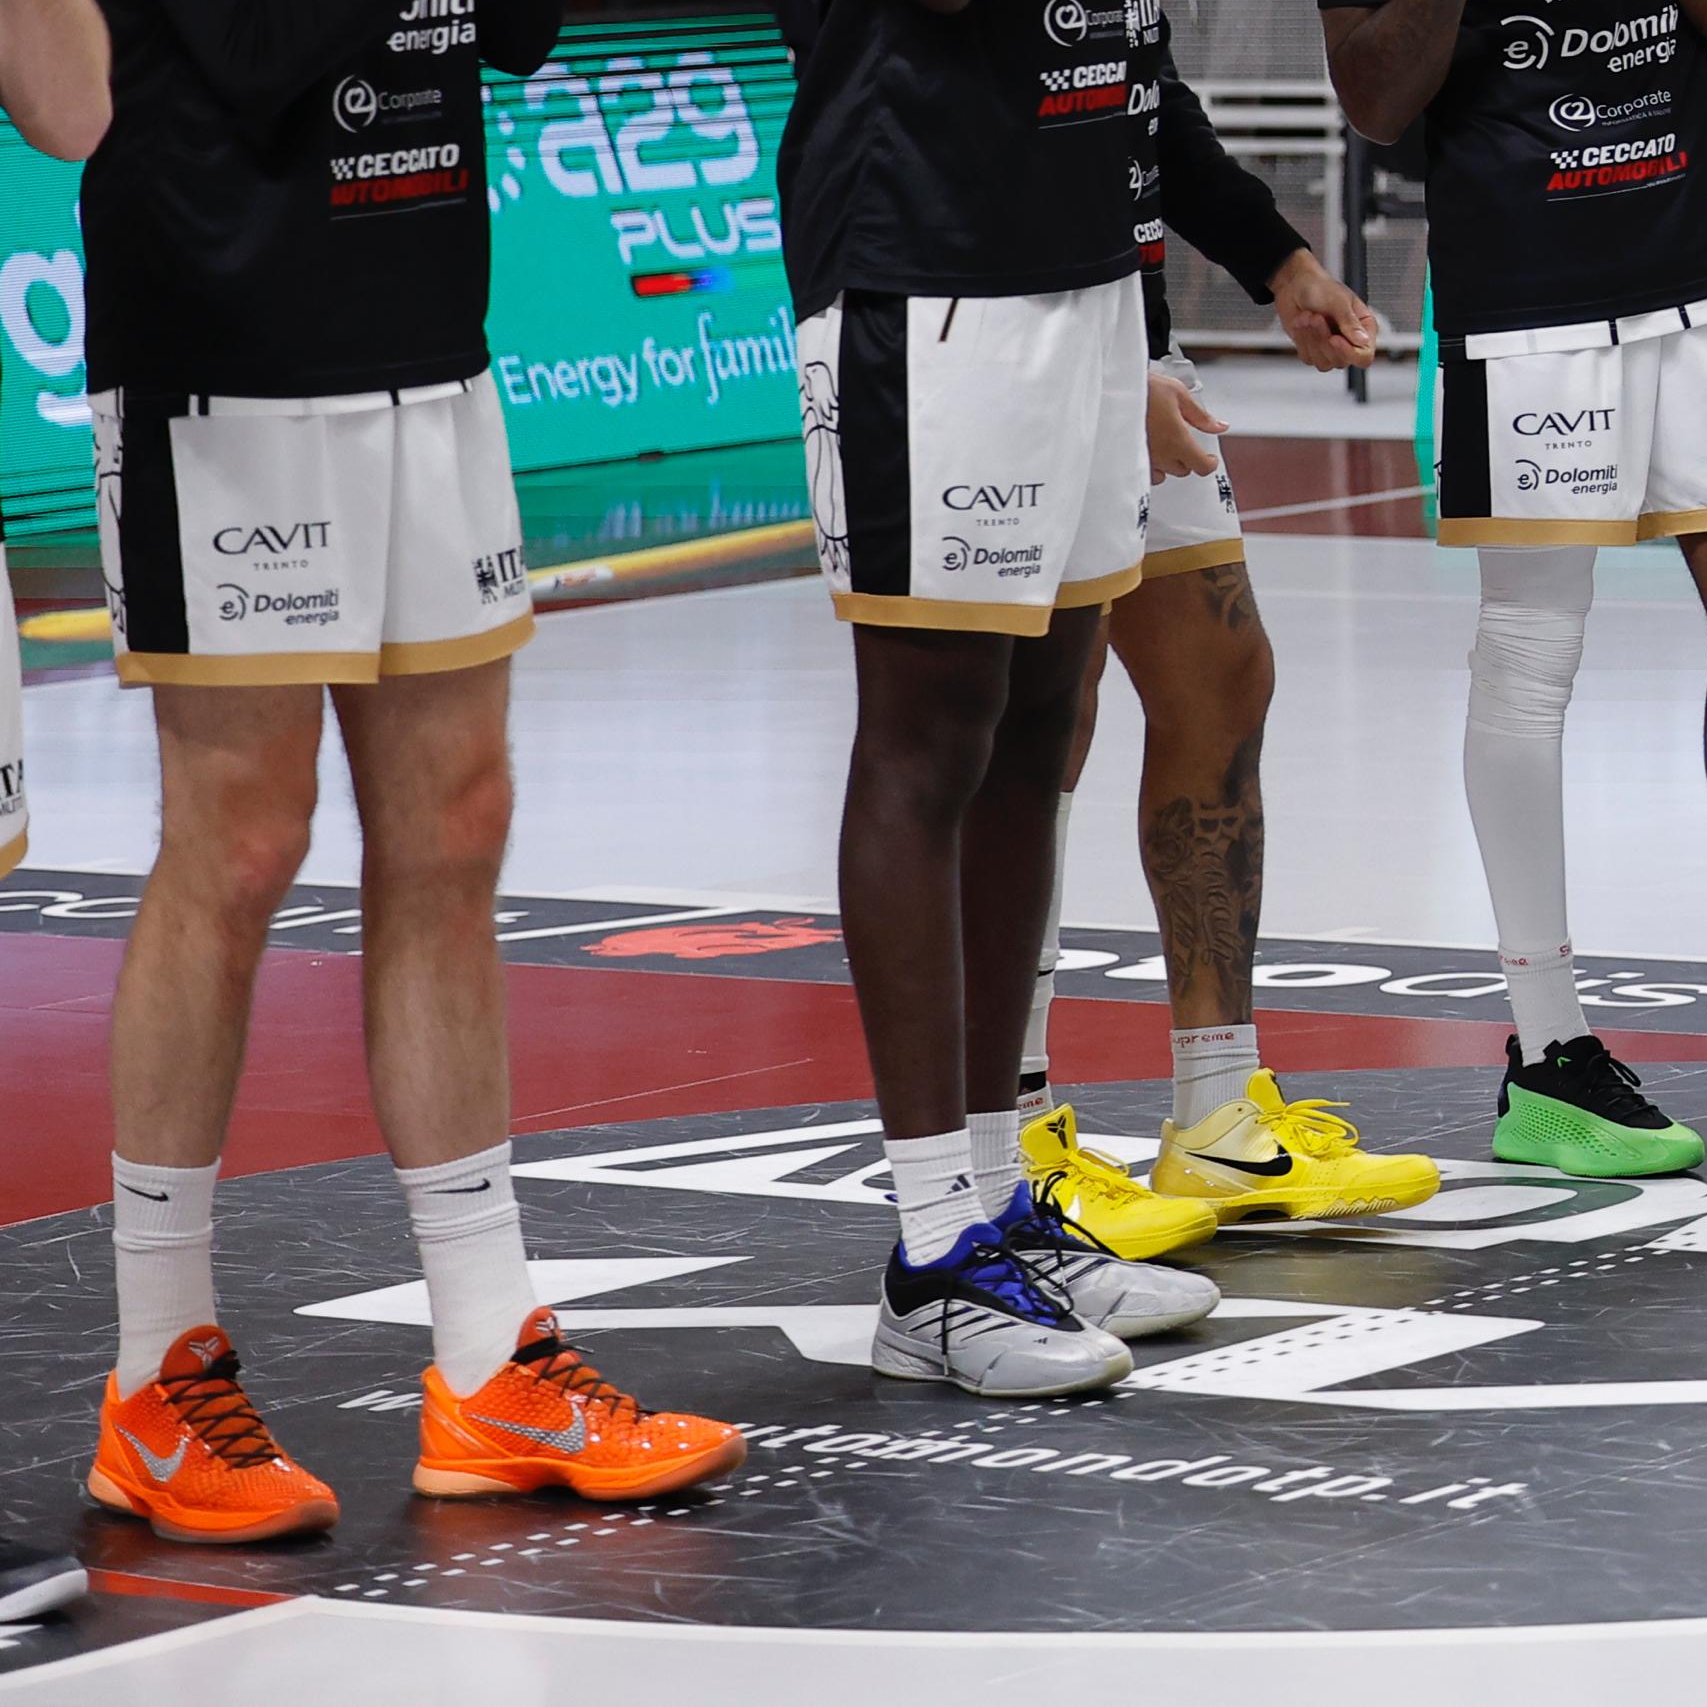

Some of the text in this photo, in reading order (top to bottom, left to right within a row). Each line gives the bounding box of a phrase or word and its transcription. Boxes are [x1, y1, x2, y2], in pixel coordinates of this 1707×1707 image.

[1073, 61, 1127, 89] CECCA
[1596, 90, 1672, 119] Corporate
[357, 143, 460, 179] CECCATO
[1582, 133, 1676, 167] CECCATO
[1547, 151, 1689, 191] AUTOMOBILI
[610, 197, 783, 266] PLUS
[498, 305, 799, 407] Energy for famil
[1512, 407, 1616, 436] CAVIT
[1545, 439, 1593, 450] TRENTO
[1544, 463, 1618, 485] Dolomiti
[1571, 479, 1618, 495] energia
[942, 482, 1045, 512] CAVIT
[976, 516, 1020, 527] TRENTO
[212, 520, 332, 556] CAVIT
[253, 559, 309, 570] TRENTO
[973, 543, 1044, 567] Dolomiti
[998, 559, 1041, 578] energia
[253, 587, 340, 614] Dolomiti
[283, 606, 340, 626] energia
[1173, 1030, 1235, 1049] upreme
